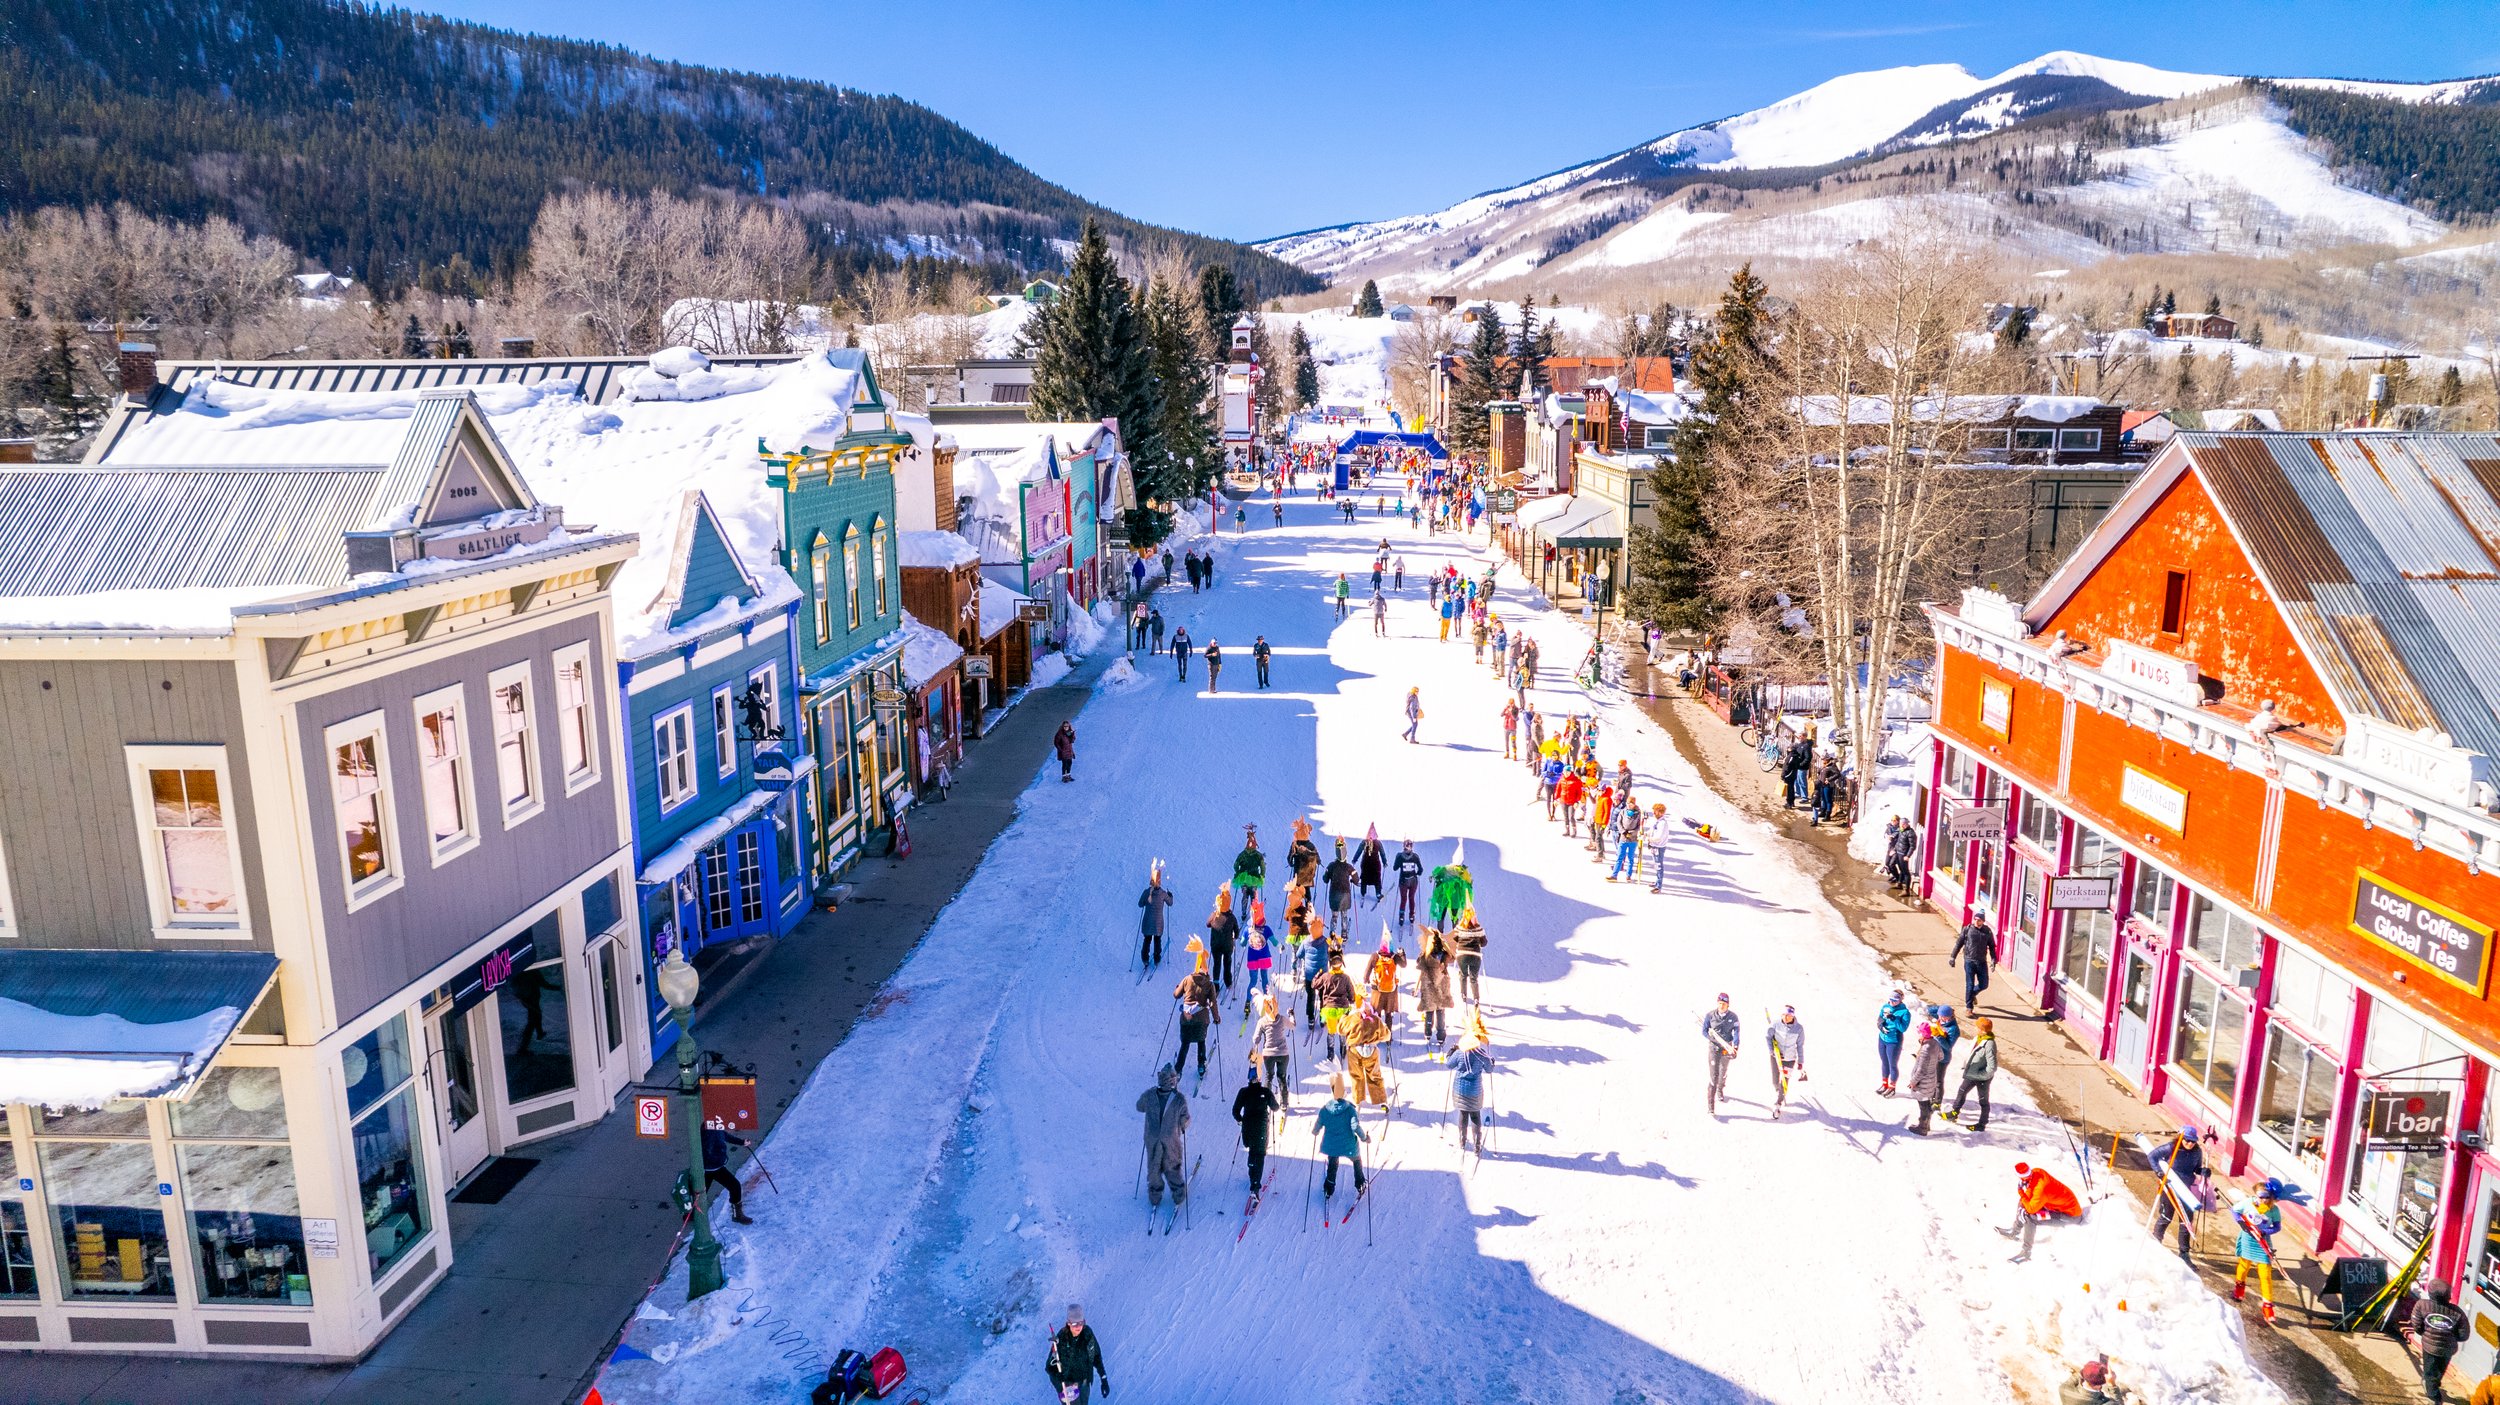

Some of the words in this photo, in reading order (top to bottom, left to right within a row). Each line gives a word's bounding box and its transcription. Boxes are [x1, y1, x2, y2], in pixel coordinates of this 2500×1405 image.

[450, 486, 478, 499] 2005
[458, 532, 521, 556] SALTLICK
[757, 758, 779, 768] TALK
[2381, 746, 2438, 783] BANK
[762, 780, 786, 791] TOWN
[1952, 829, 2001, 839] ANGLER
[2055, 886, 2107, 899] björkstam
[2370, 886, 2412, 922] Local
[2416, 909, 2470, 950] Coffee
[2374, 915, 2421, 954] Global
[2427, 941, 2457, 972] Tea
[481, 948, 512, 992] LAVISH
[2379, 1097, 2443, 1133] T-bar
[2370, 1143, 2406, 1151] International
[312, 1221, 328, 1229] Art
